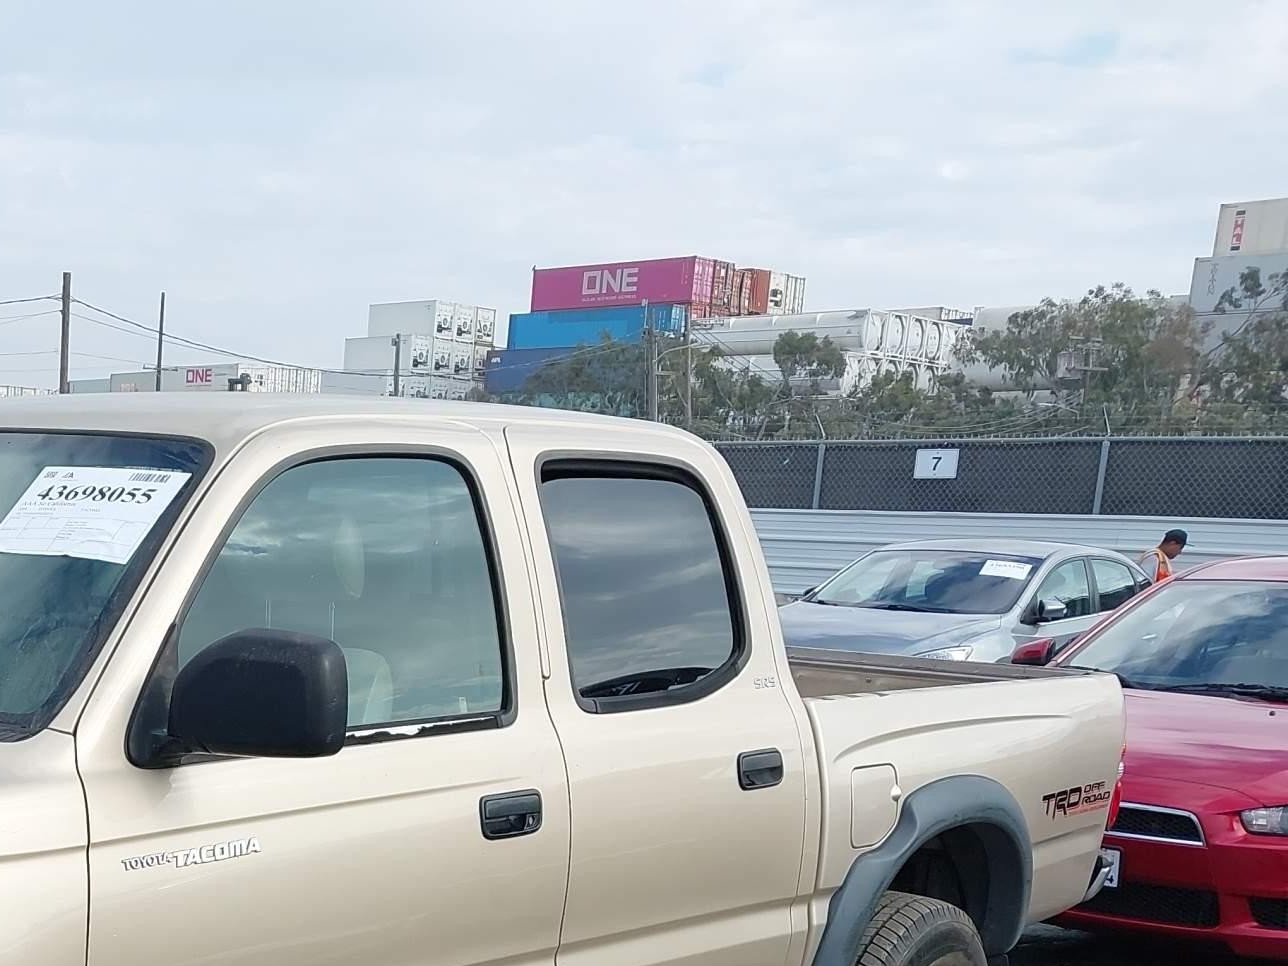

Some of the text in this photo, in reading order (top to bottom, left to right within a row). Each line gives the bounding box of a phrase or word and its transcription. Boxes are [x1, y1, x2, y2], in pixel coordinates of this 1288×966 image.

[582, 268, 639, 295] ONE
[186, 369, 212, 383] ONE
[932, 456, 942, 471] 7
[37, 485, 158, 504] 43698055
[1042, 781, 1106, 820] TRD OFF
[1081, 791, 1111, 805] ROAD
[121, 836, 262, 871] TOYOTA TACOMA
